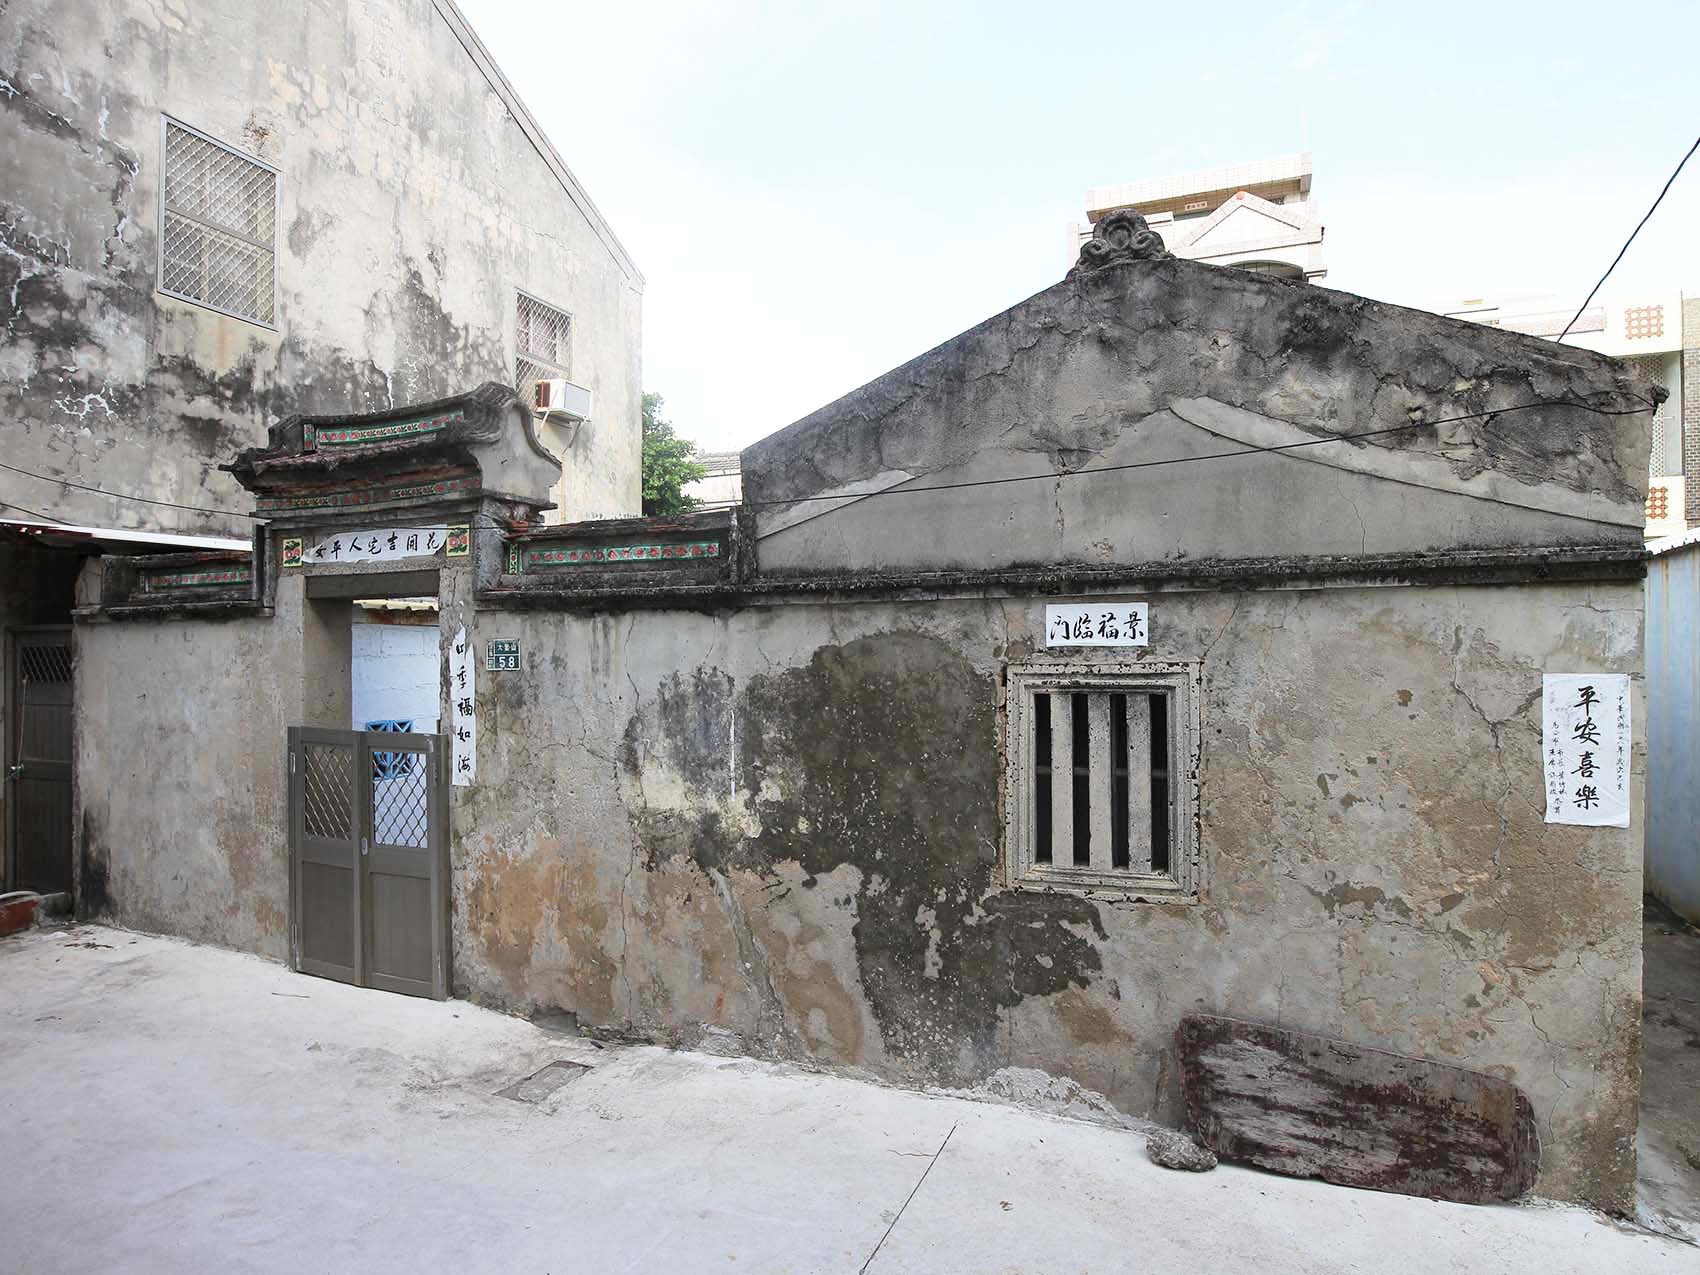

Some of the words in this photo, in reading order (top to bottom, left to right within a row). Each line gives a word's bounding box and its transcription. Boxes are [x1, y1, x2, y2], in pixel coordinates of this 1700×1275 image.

[1050, 610, 1144, 641] 景福臨門
[499, 656, 515, 668] 58
[1571, 685, 1601, 810] 平安喜樂
